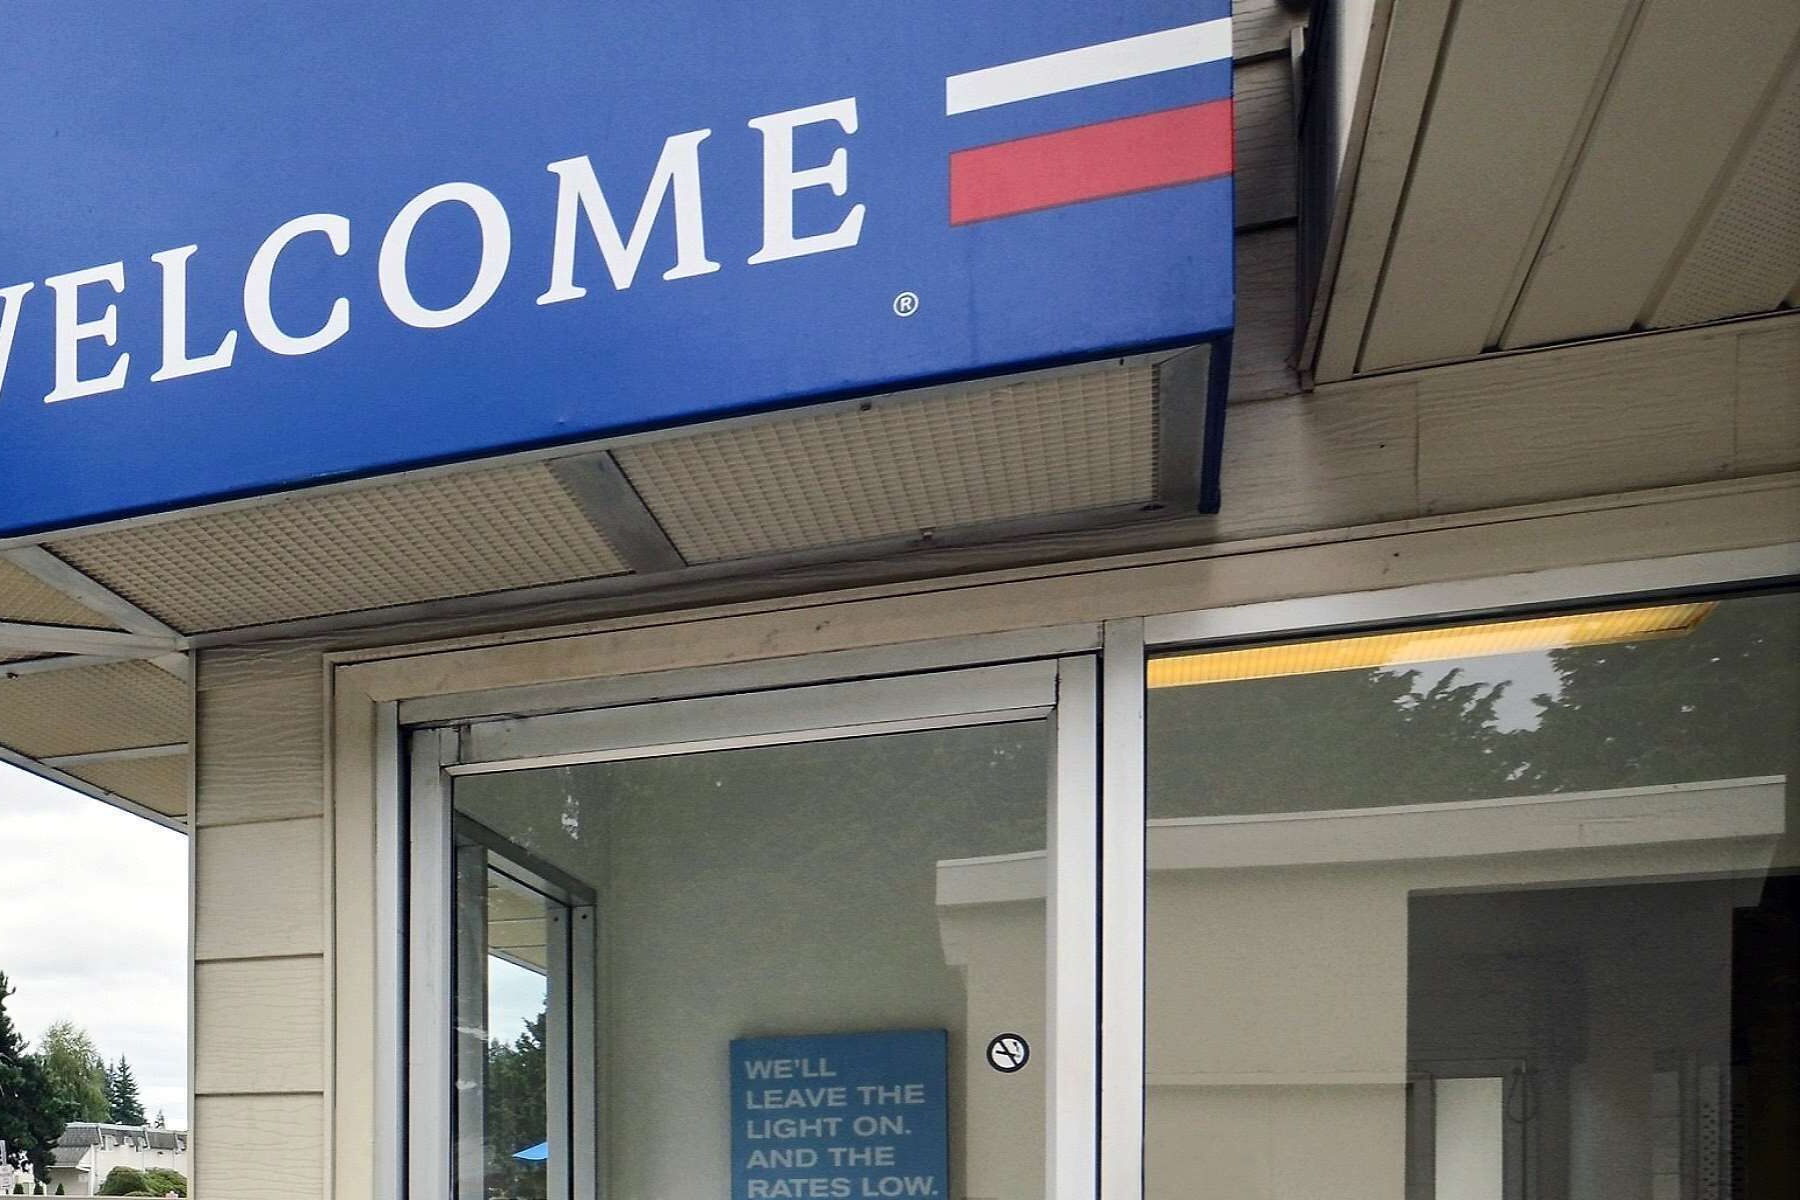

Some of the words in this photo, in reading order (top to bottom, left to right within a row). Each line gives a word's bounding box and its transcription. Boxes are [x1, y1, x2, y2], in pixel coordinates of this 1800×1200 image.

[744, 1058, 837, 1079] WE'LL
[746, 1087, 847, 1110] LEAVE
[857, 1084, 926, 1105] THE
[747, 1117, 843, 1139] LIGHT
[853, 1115, 912, 1137] ON.
[747, 1149, 819, 1169] AND
[827, 1146, 895, 1167] THE
[747, 1177, 851, 1199] RATES
[861, 1176, 939, 1197] LOW.
